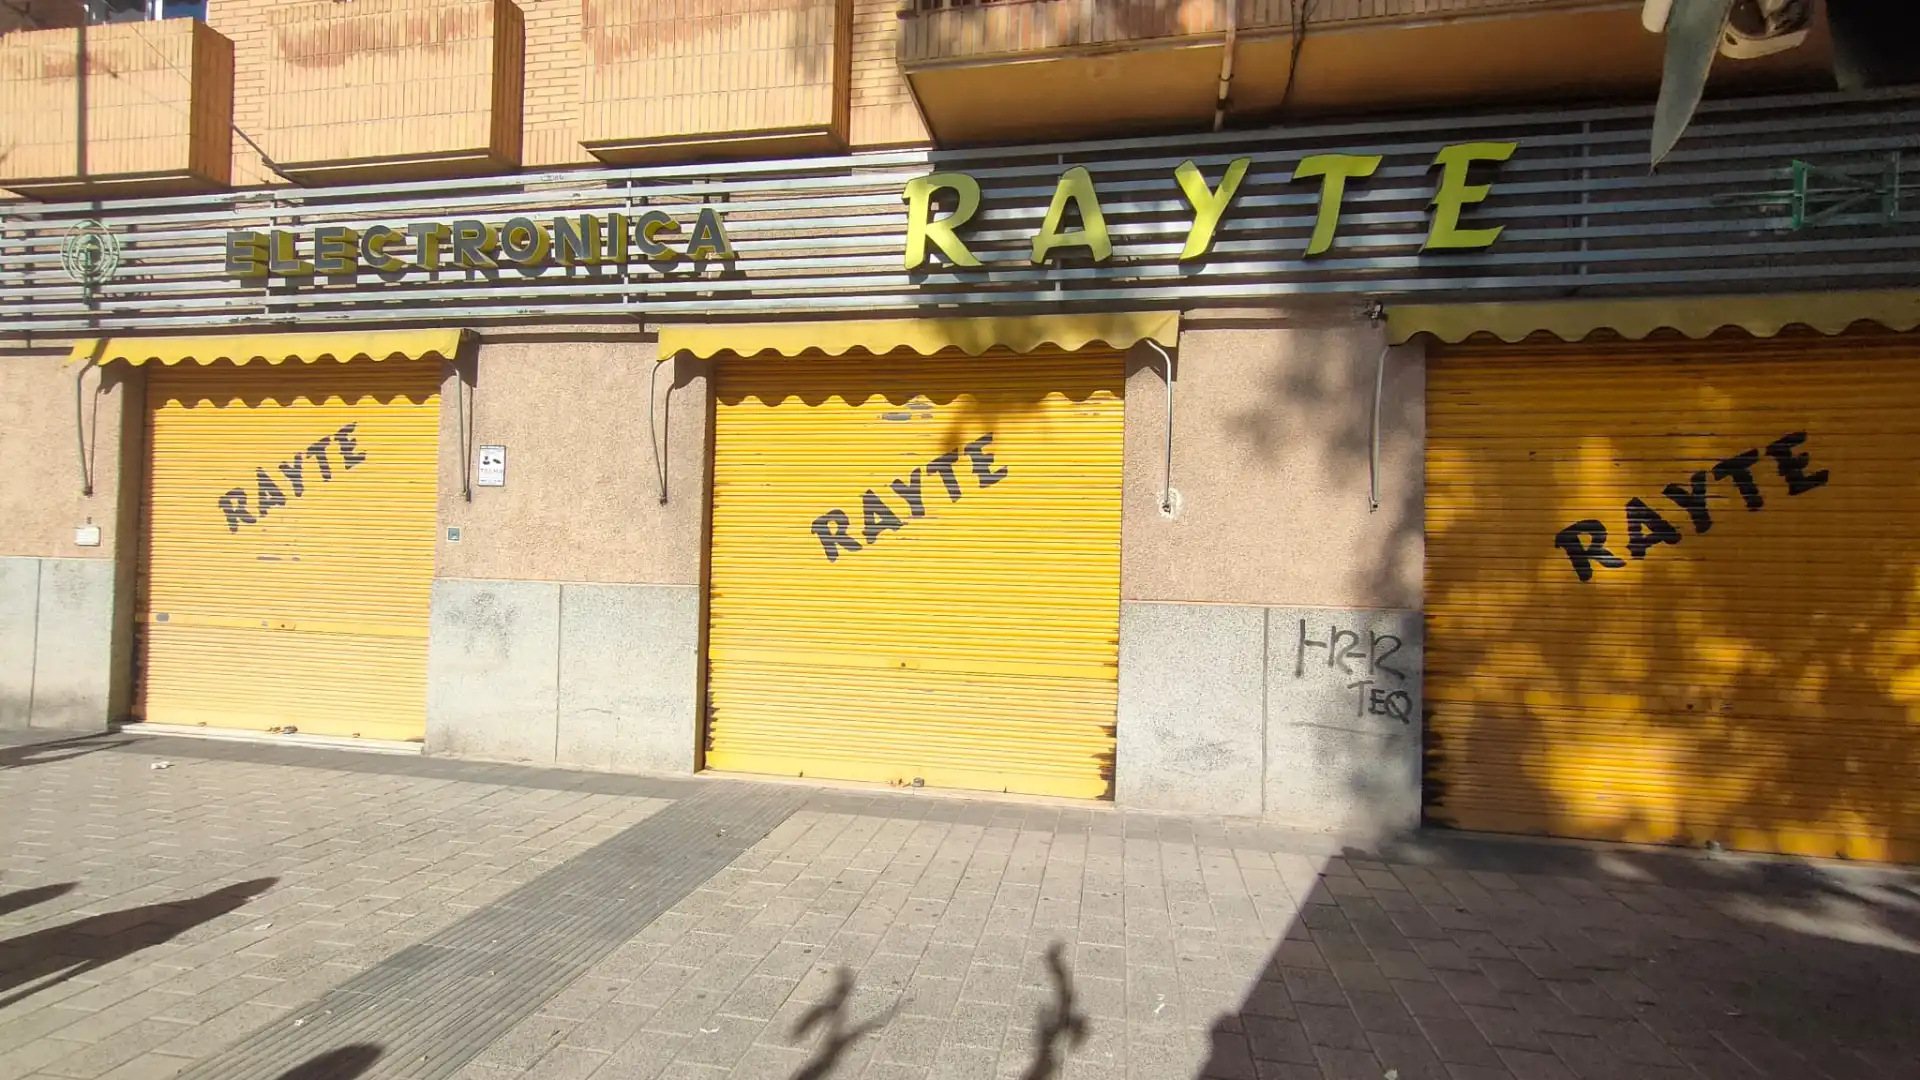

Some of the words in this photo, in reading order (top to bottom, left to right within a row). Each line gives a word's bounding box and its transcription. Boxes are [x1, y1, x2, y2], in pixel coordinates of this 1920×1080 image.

[225, 208, 735, 276] ELECTRONICA
[902, 141, 1520, 270] RAYTE
[218, 421, 367, 535] RAYTE
[811, 432, 1009, 563] RAYTE
[1555, 430, 1830, 583] RAYTE
